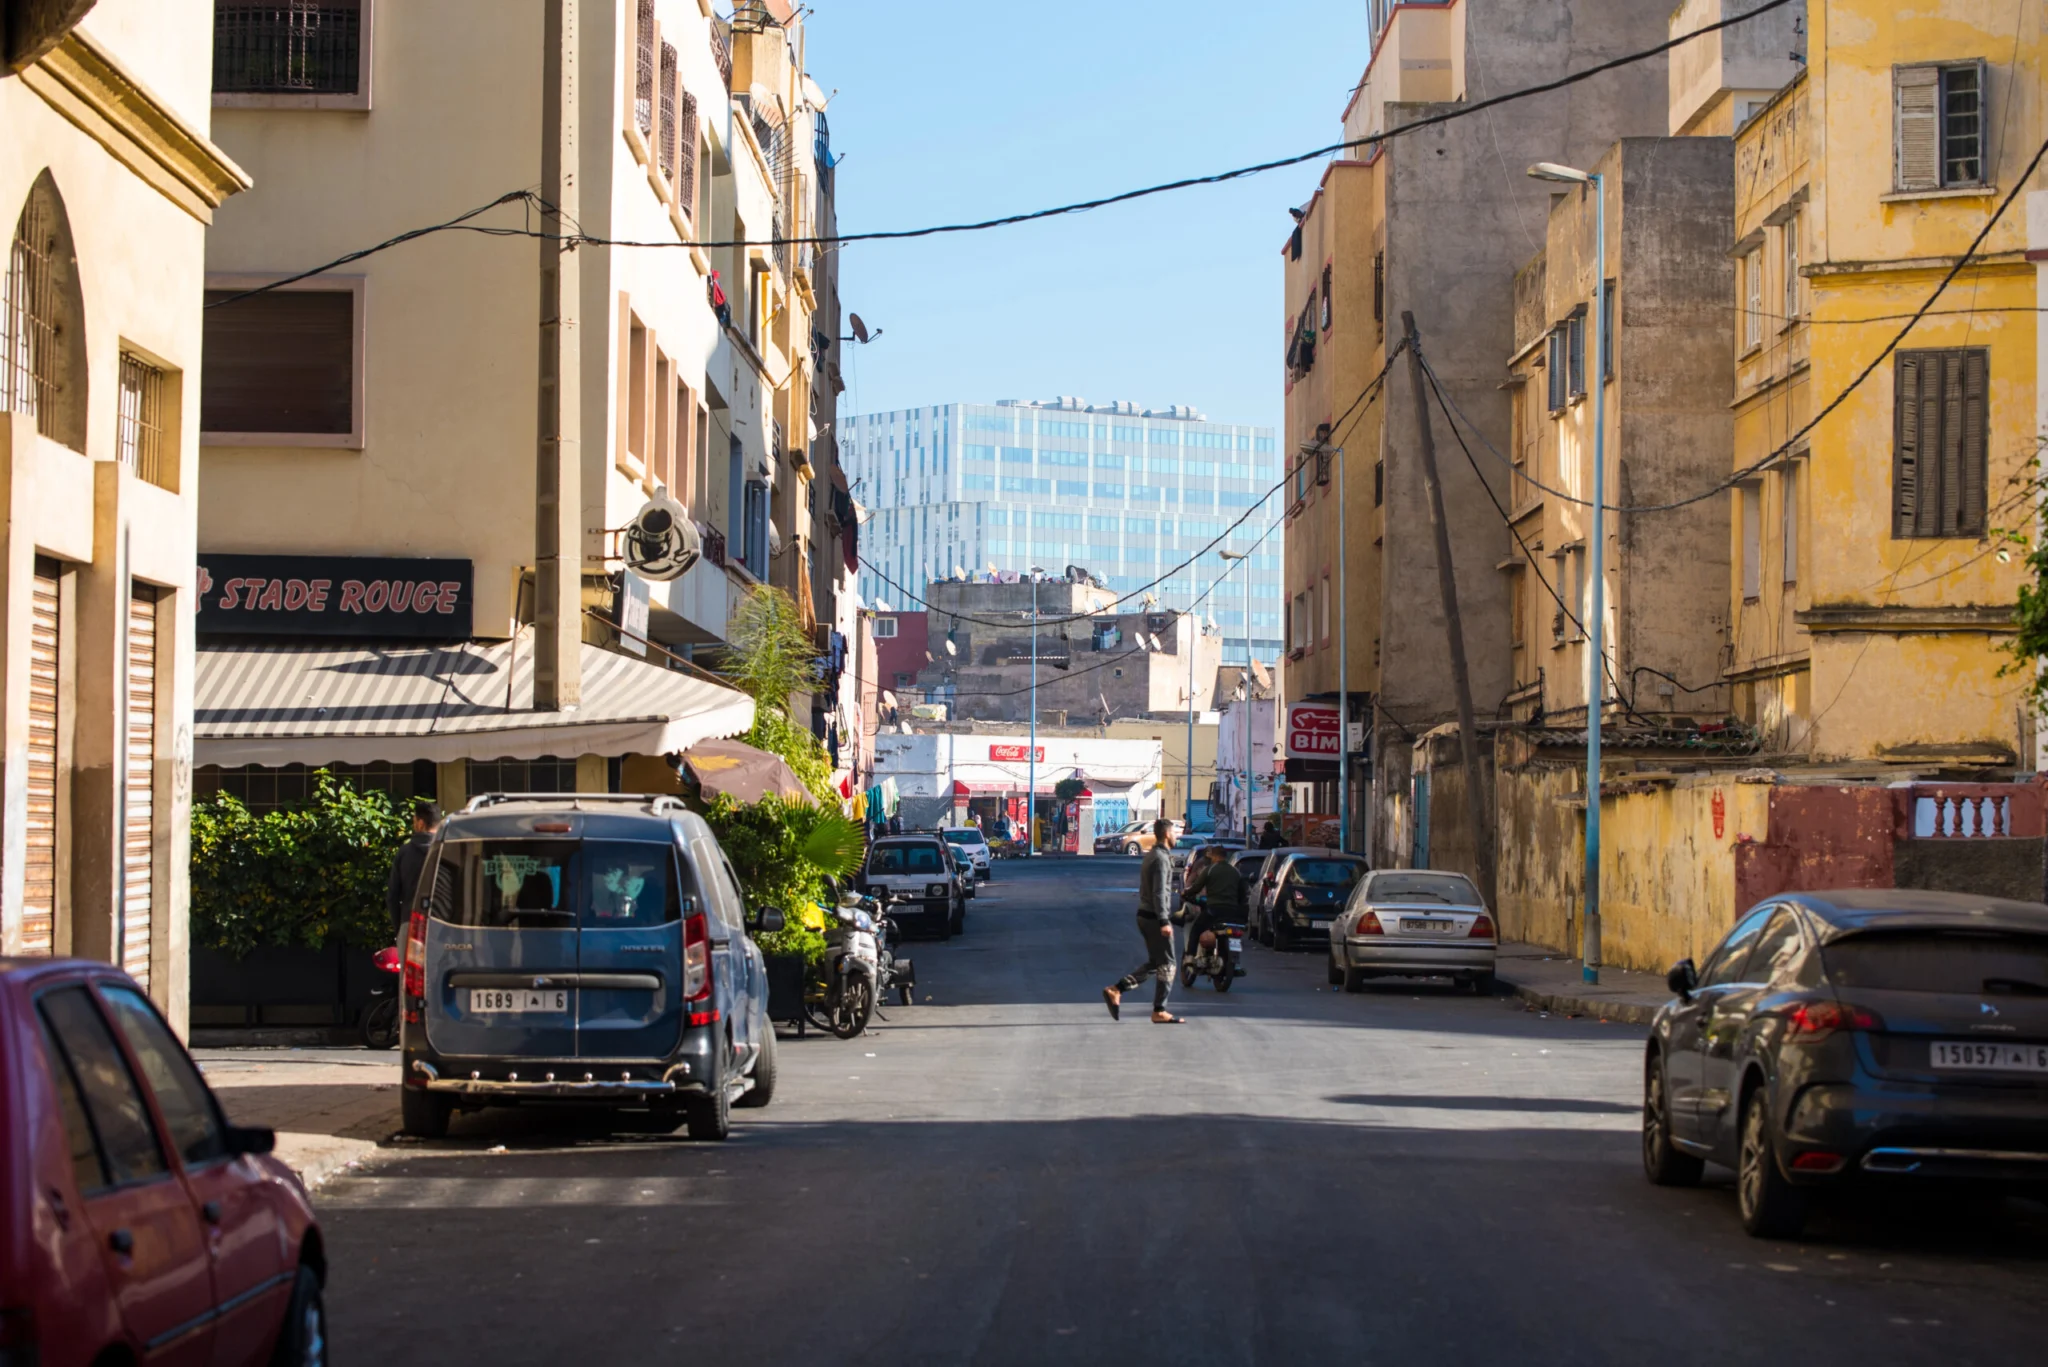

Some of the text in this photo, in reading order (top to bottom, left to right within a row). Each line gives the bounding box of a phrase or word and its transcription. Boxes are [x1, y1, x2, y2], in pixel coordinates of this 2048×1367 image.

[219, 578, 461, 614] STADE ROUGE
[1295, 734, 1339, 751] BIM
[476, 993, 513, 1008] 1689
[555, 993, 564, 1009] 6
[1939, 1045, 1997, 1065] 15057
[2037, 1048, 2048, 1068] 6
